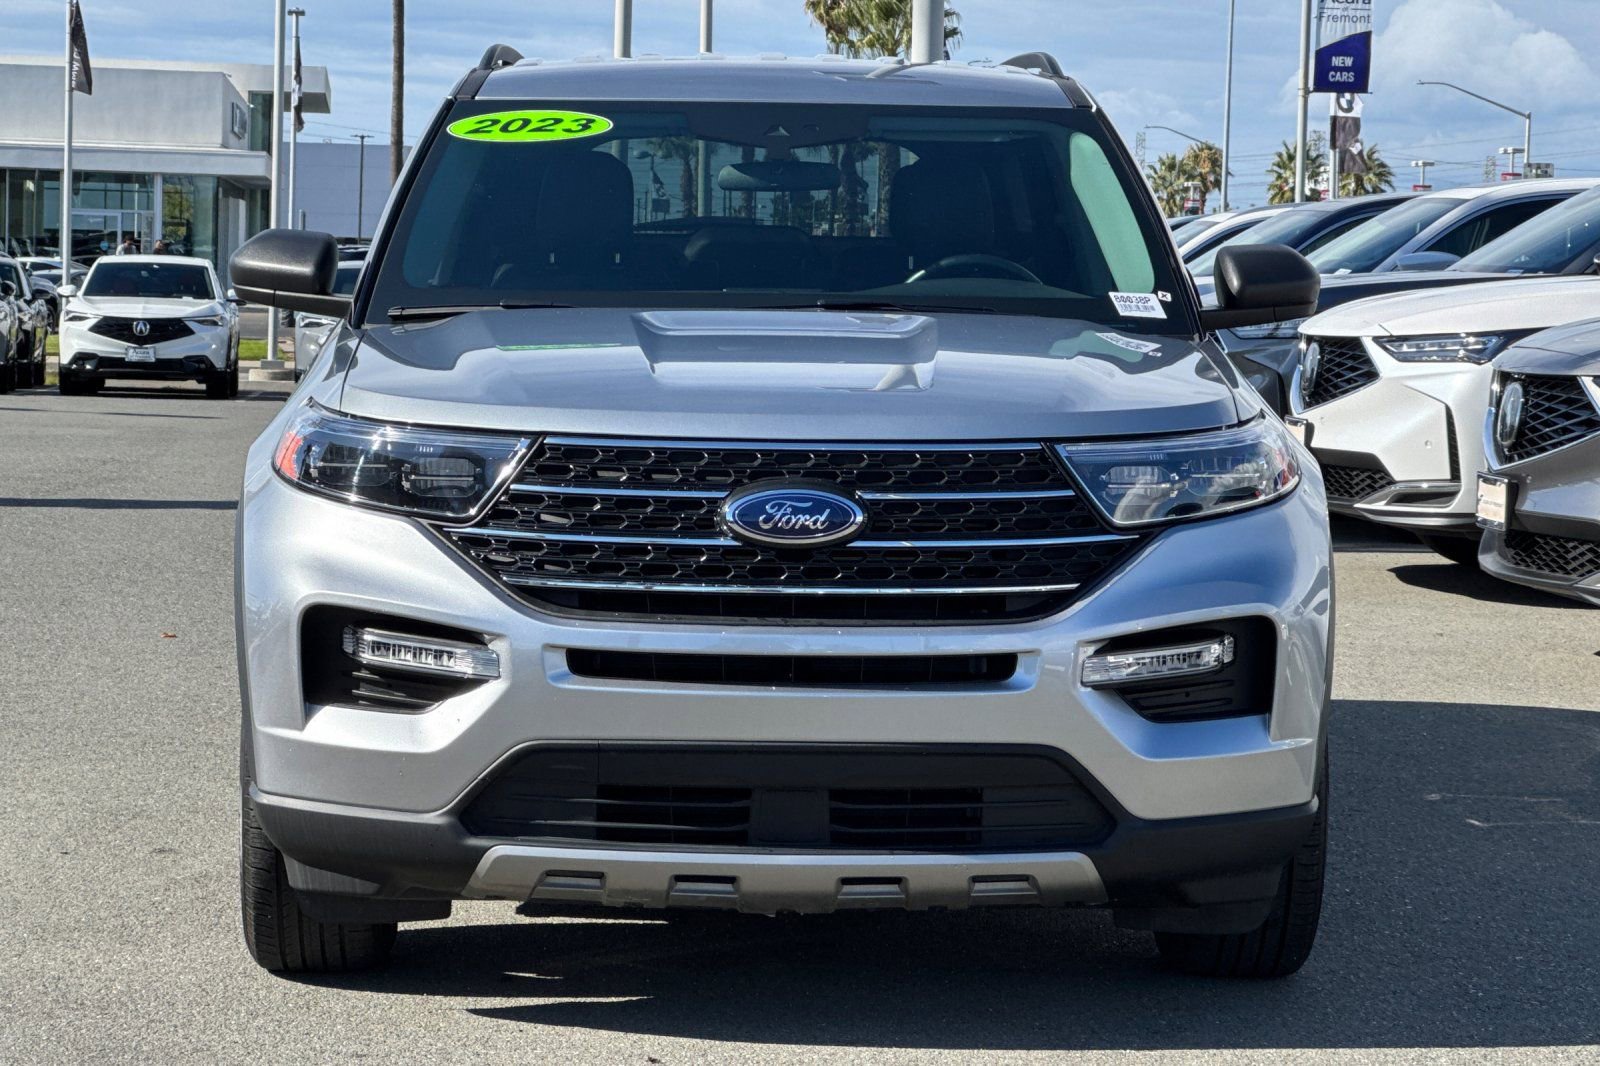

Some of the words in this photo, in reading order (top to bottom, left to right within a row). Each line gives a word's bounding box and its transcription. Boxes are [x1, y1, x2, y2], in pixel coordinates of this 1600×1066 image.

[1318, 12, 1372, 23] Fremont
[1331, 56, 1354, 67] NEW
[1328, 71, 1355, 82] CARS
[463, 117, 597, 135] 2023
[758, 499, 831, 530] Ford
